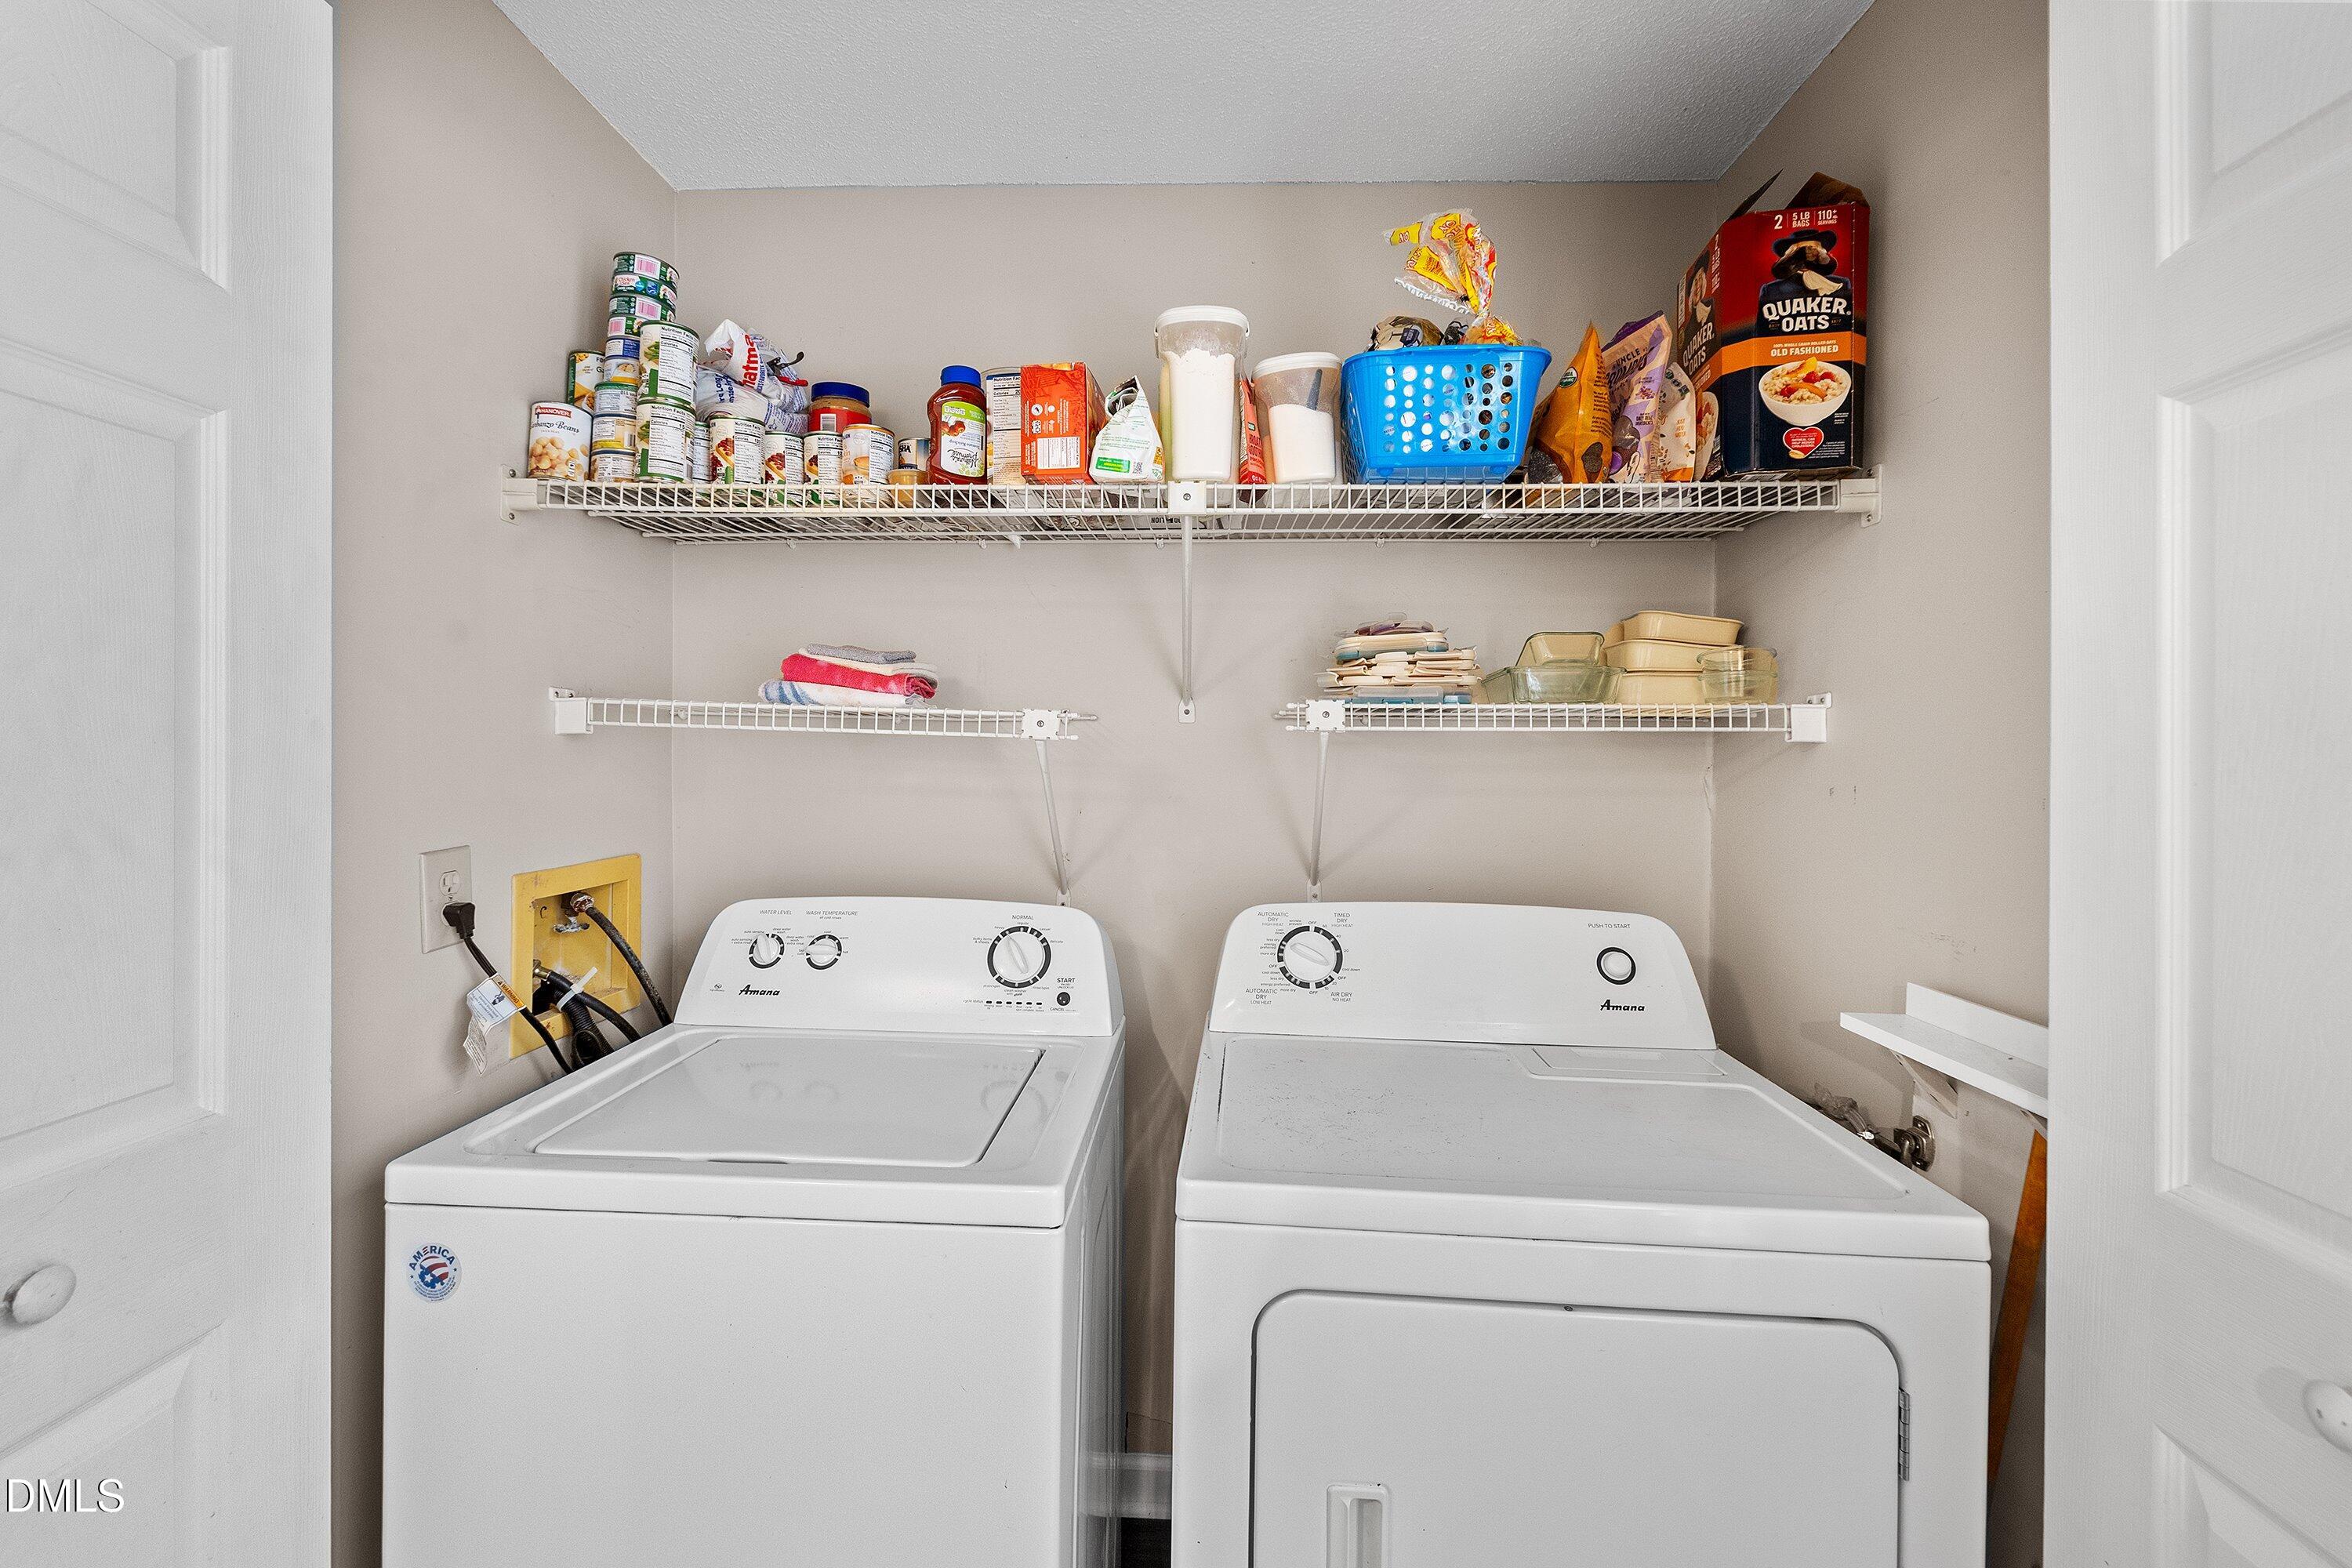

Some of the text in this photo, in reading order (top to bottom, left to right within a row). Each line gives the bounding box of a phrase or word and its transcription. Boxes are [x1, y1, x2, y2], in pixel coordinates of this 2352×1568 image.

[1774, 214, 1783, 229] 2
[1792, 211, 1810, 221] 5 LB
[1792, 220, 1809, 228] BAGS
[1762, 296, 1847, 321] QUAKER
[662, 326, 682, 335] Nutrition
[1781, 315, 1830, 332] OATS
[1616, 348, 1641, 366] UNCLE
[1770, 345, 1838, 357] OLD FASHIONED
[1689, 346, 1707, 376] OATS
[541, 408, 570, 416] HANOVER
[555, 420, 579, 434] Beans
[502, 982, 520, 1004] WARNING
[739, 984, 781, 996] Amana
[1600, 999, 1646, 1012] Amana
[409, 1245, 456, 1271] AMERICA
